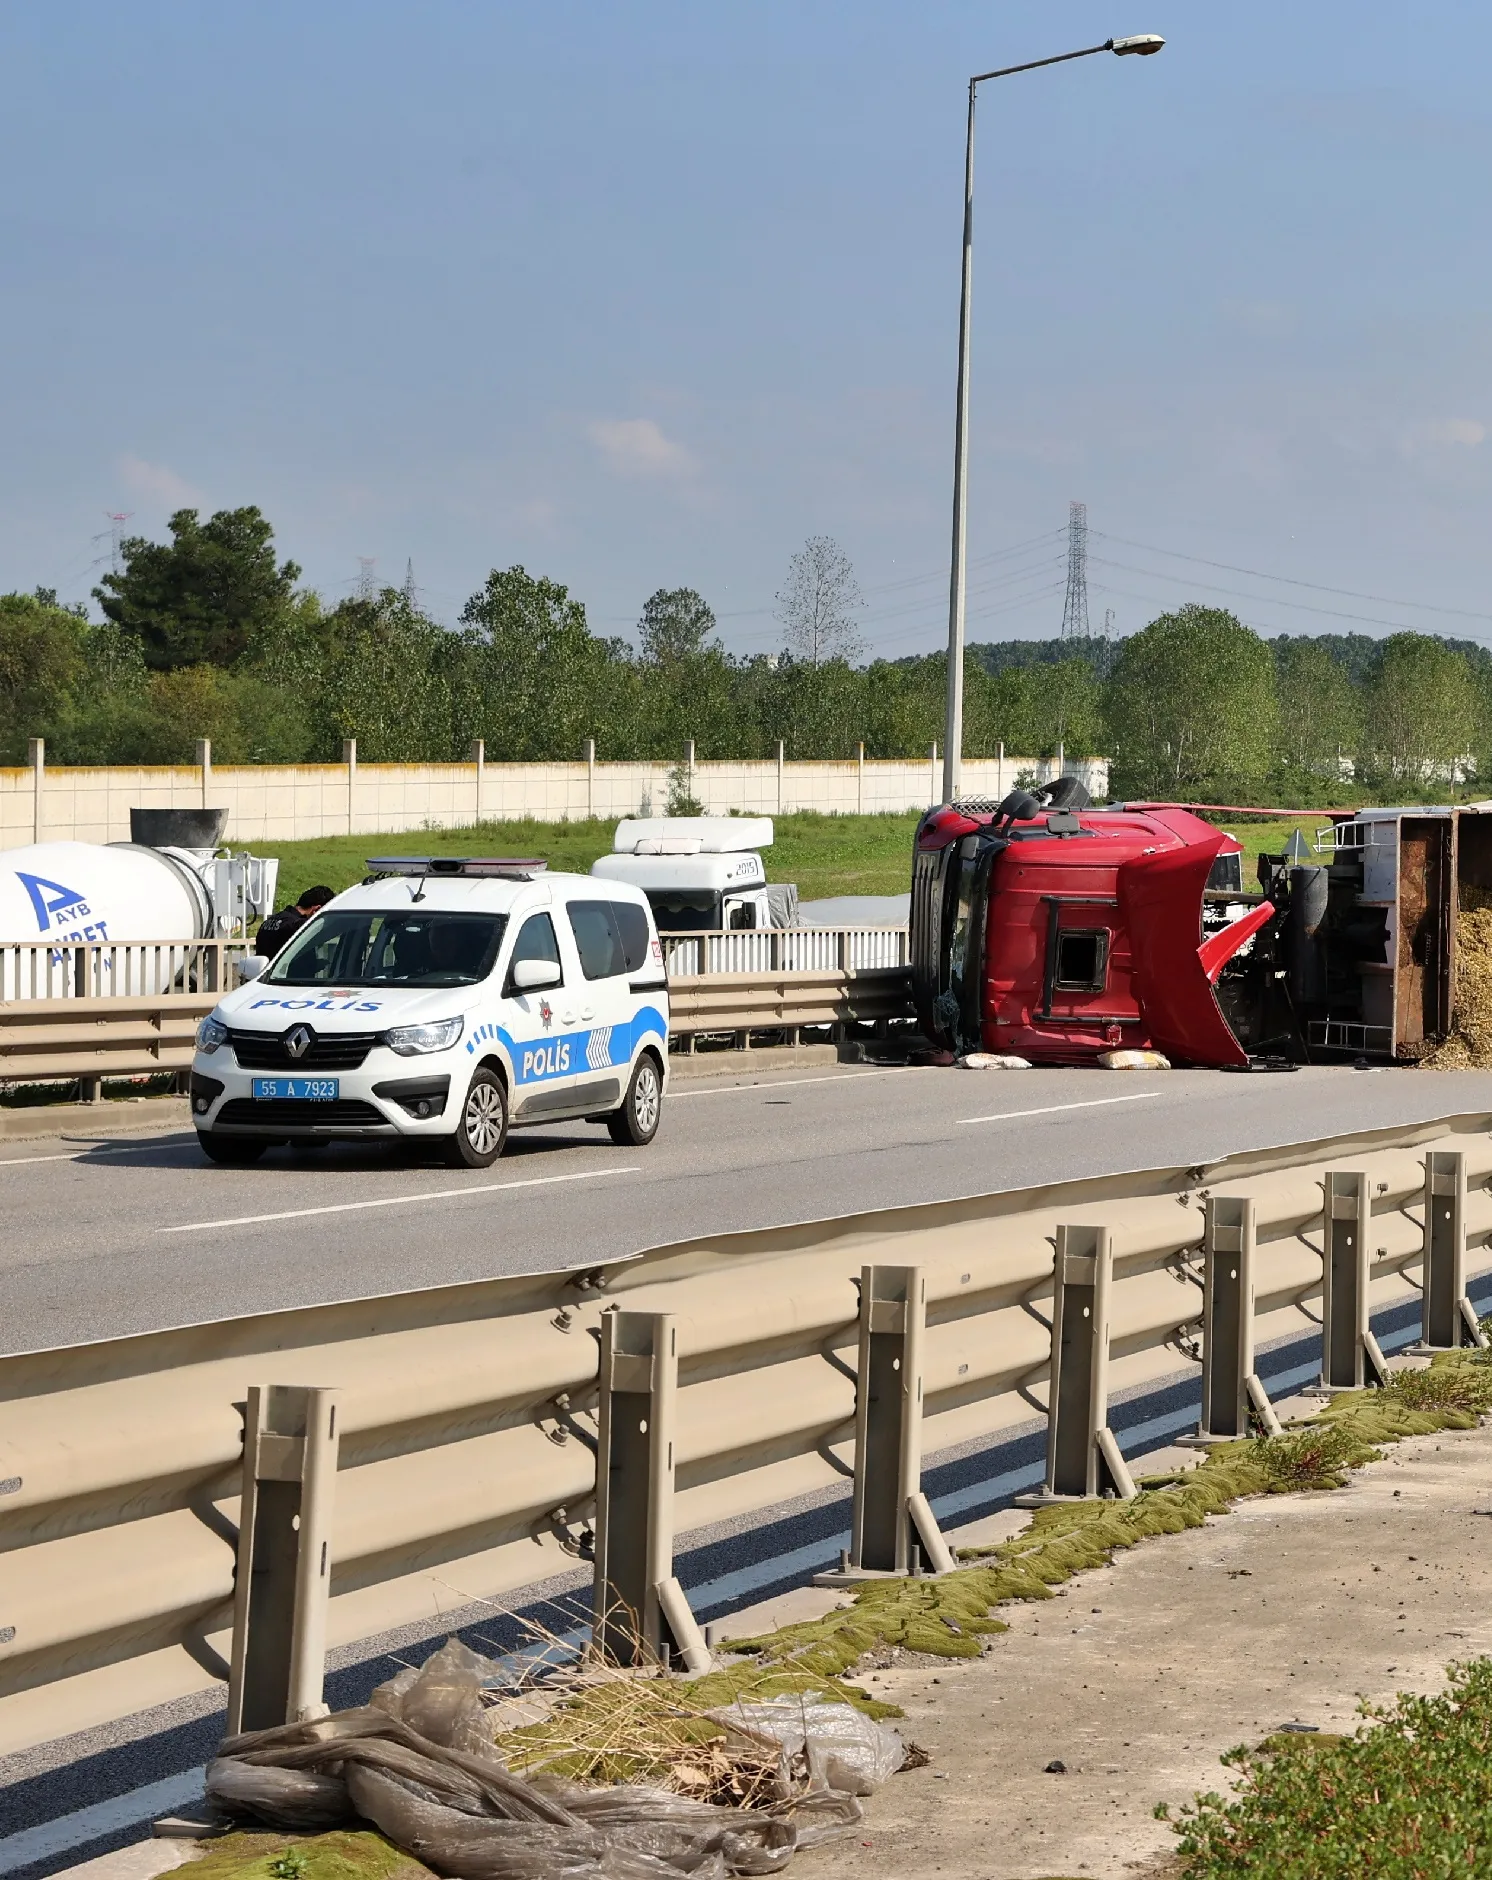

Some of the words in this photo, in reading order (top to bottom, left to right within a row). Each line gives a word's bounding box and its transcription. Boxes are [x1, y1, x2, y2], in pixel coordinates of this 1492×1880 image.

[55, 903, 91, 925] AYB
[523, 1039, 570, 1079] POLİS
[262, 1081, 277, 1096] 55
[287, 1081, 295, 1096] A
[304, 1081, 335, 1097] 7923
